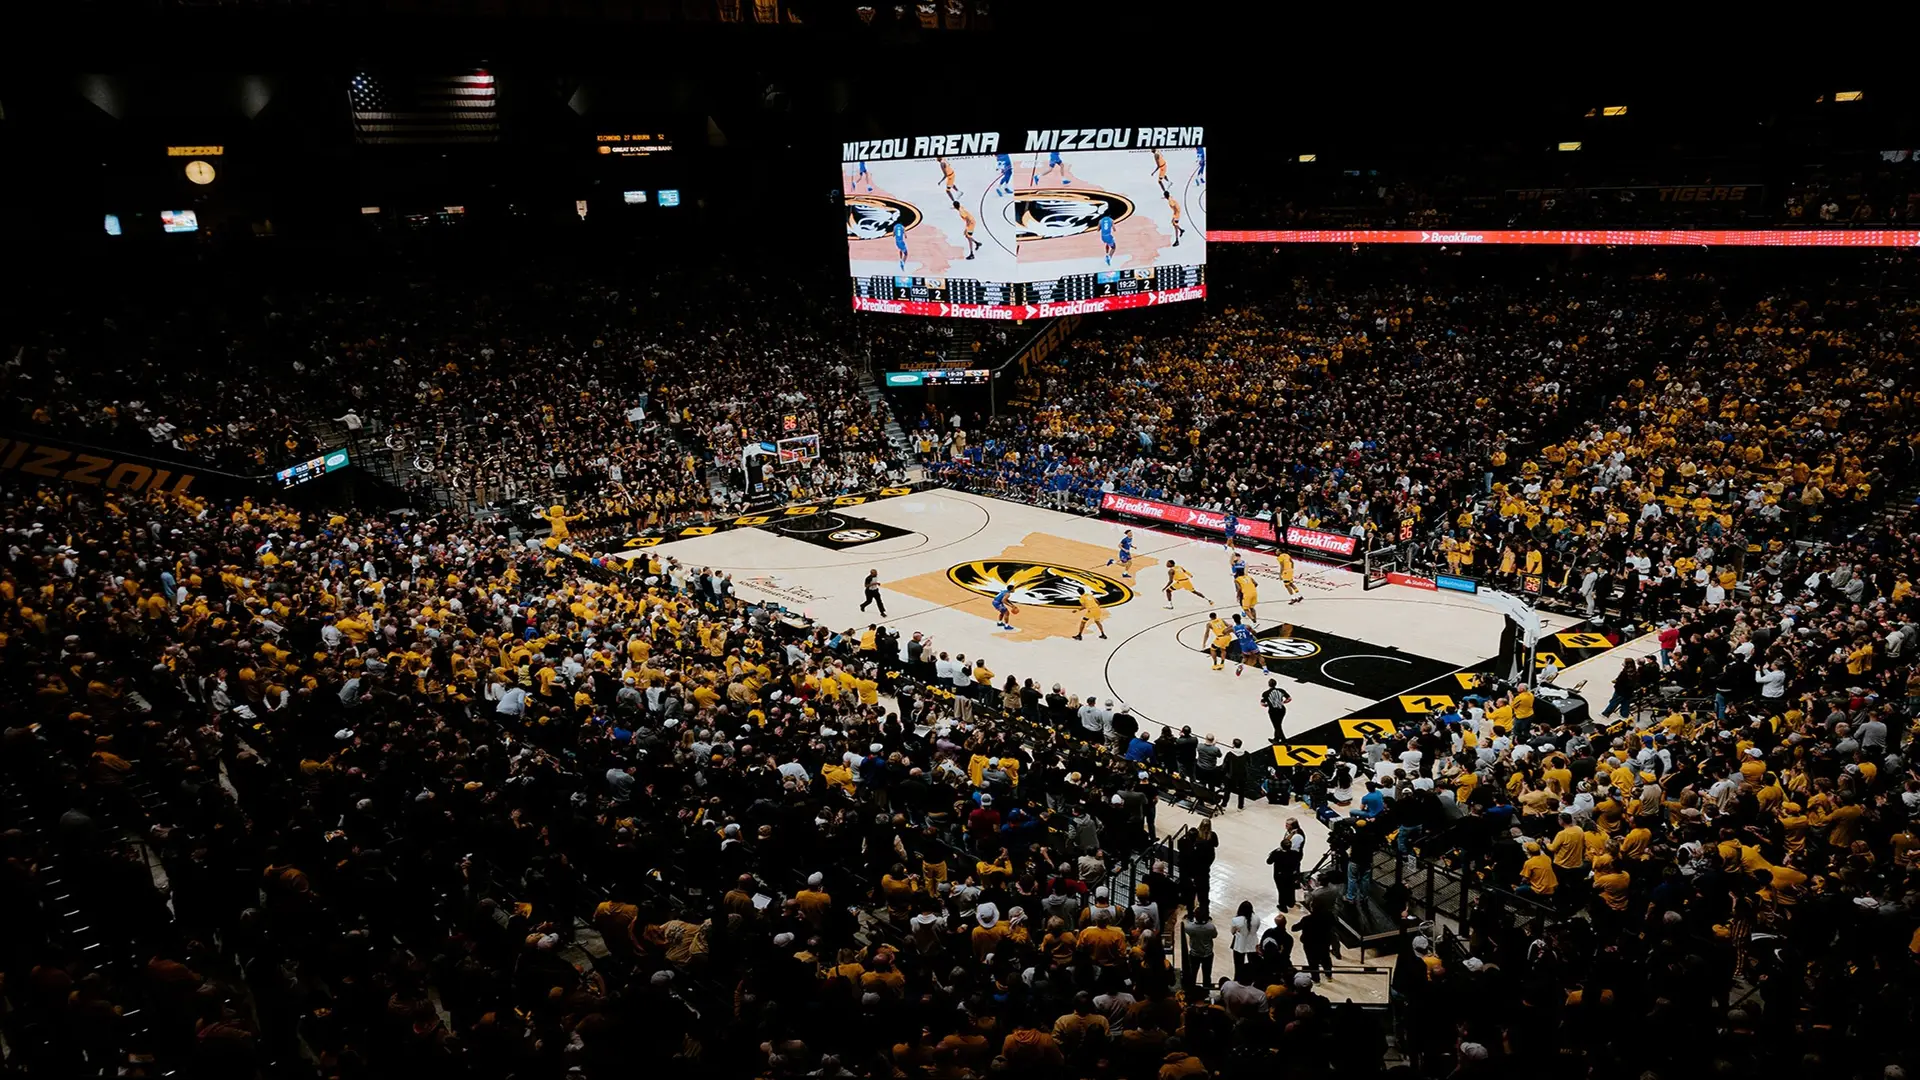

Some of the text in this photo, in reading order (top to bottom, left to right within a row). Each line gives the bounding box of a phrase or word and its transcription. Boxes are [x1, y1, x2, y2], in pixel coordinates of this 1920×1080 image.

[842, 132, 999, 161] MIZZOU ARENA
[1025, 126, 1203, 151] MIZZOU ARENA
[1658, 186, 1747, 202] TIGERS
[1431, 232, 1483, 242] BreakTime
[900, 288, 907, 298] 2
[935, 290, 942, 300] 2
[1104, 280, 1150, 294] 2 19:25 2
[1158, 288, 1203, 304] BreakTime
[861, 299, 1013, 319] BreakTime BreakTime
[1039, 302, 1105, 318] BreakTime
[1115, 498, 1164, 517] BreakTime
[1197, 514, 1251, 533] Breame
[1288, 530, 1350, 552] BreakTime
[1400, 526, 1412, 540] 26
[1526, 583, 1538, 591] 26
